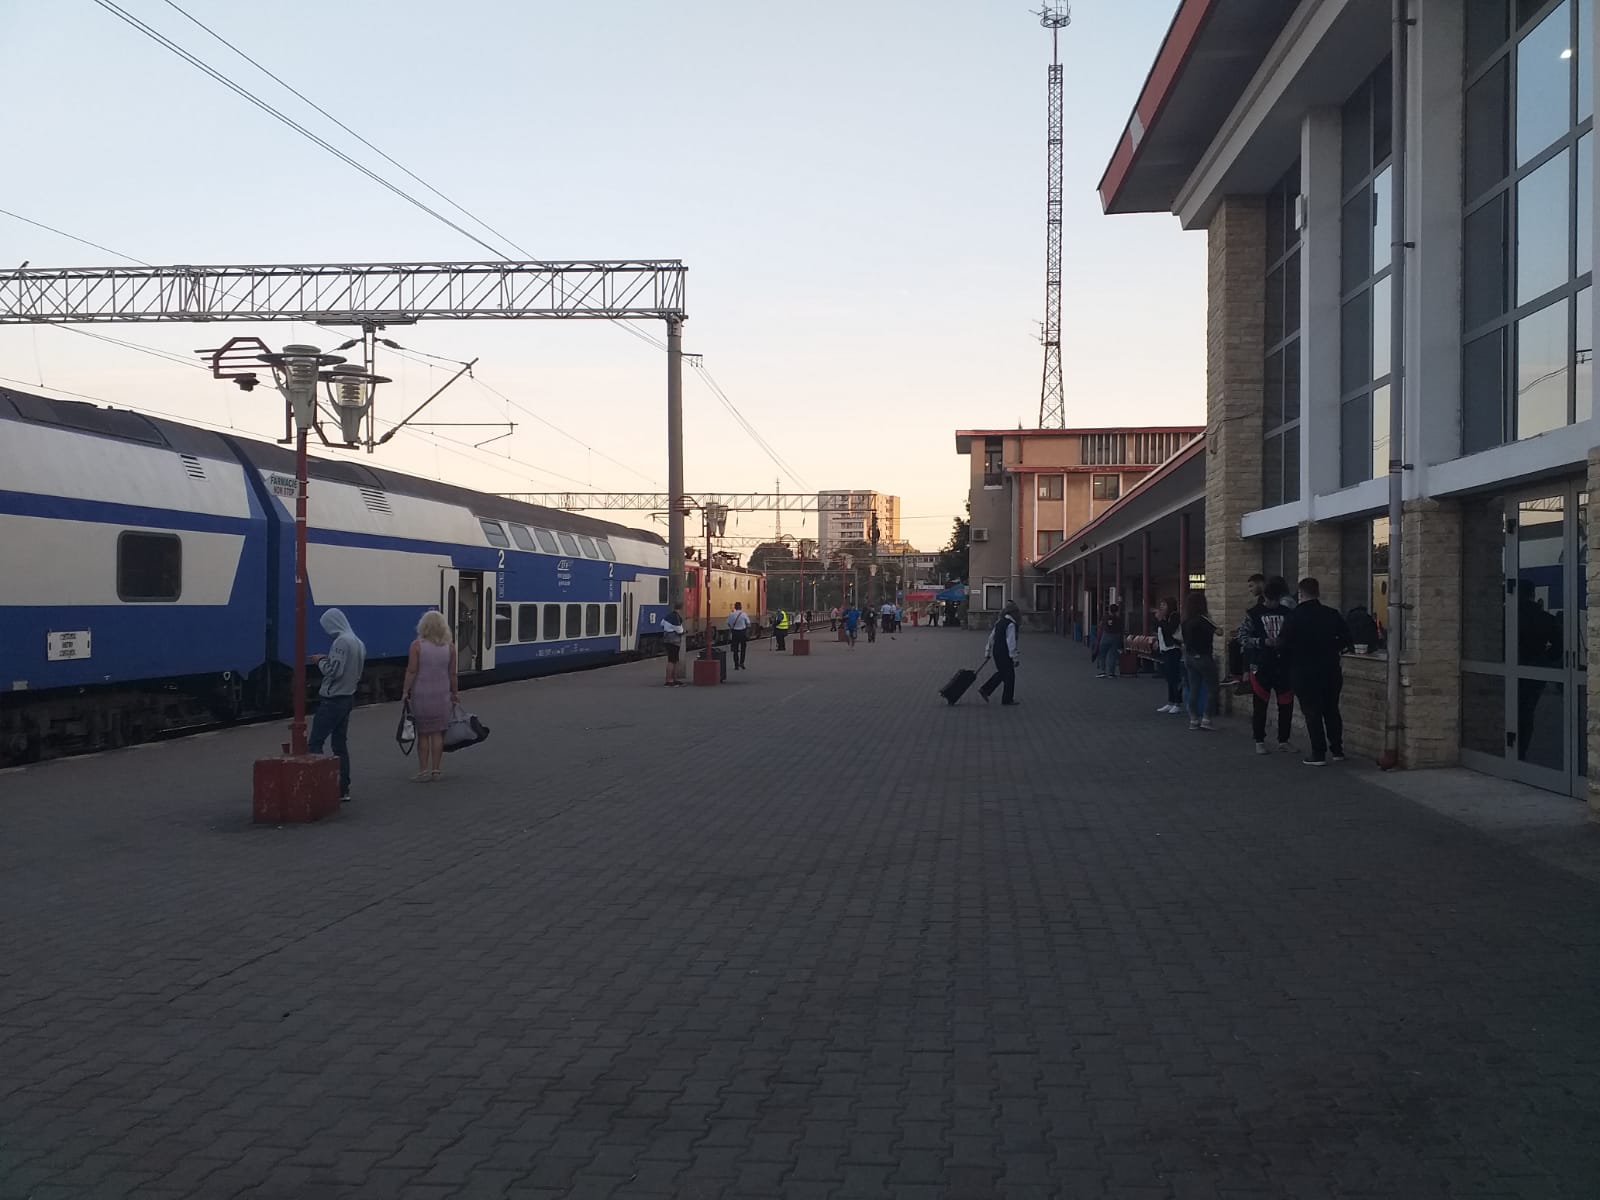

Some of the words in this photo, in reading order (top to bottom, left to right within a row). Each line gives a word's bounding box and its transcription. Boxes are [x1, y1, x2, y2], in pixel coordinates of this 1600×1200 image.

[270, 476, 298, 488] FARMACIE
[498, 549, 505, 568] 2
[609, 563, 614, 578] 2
